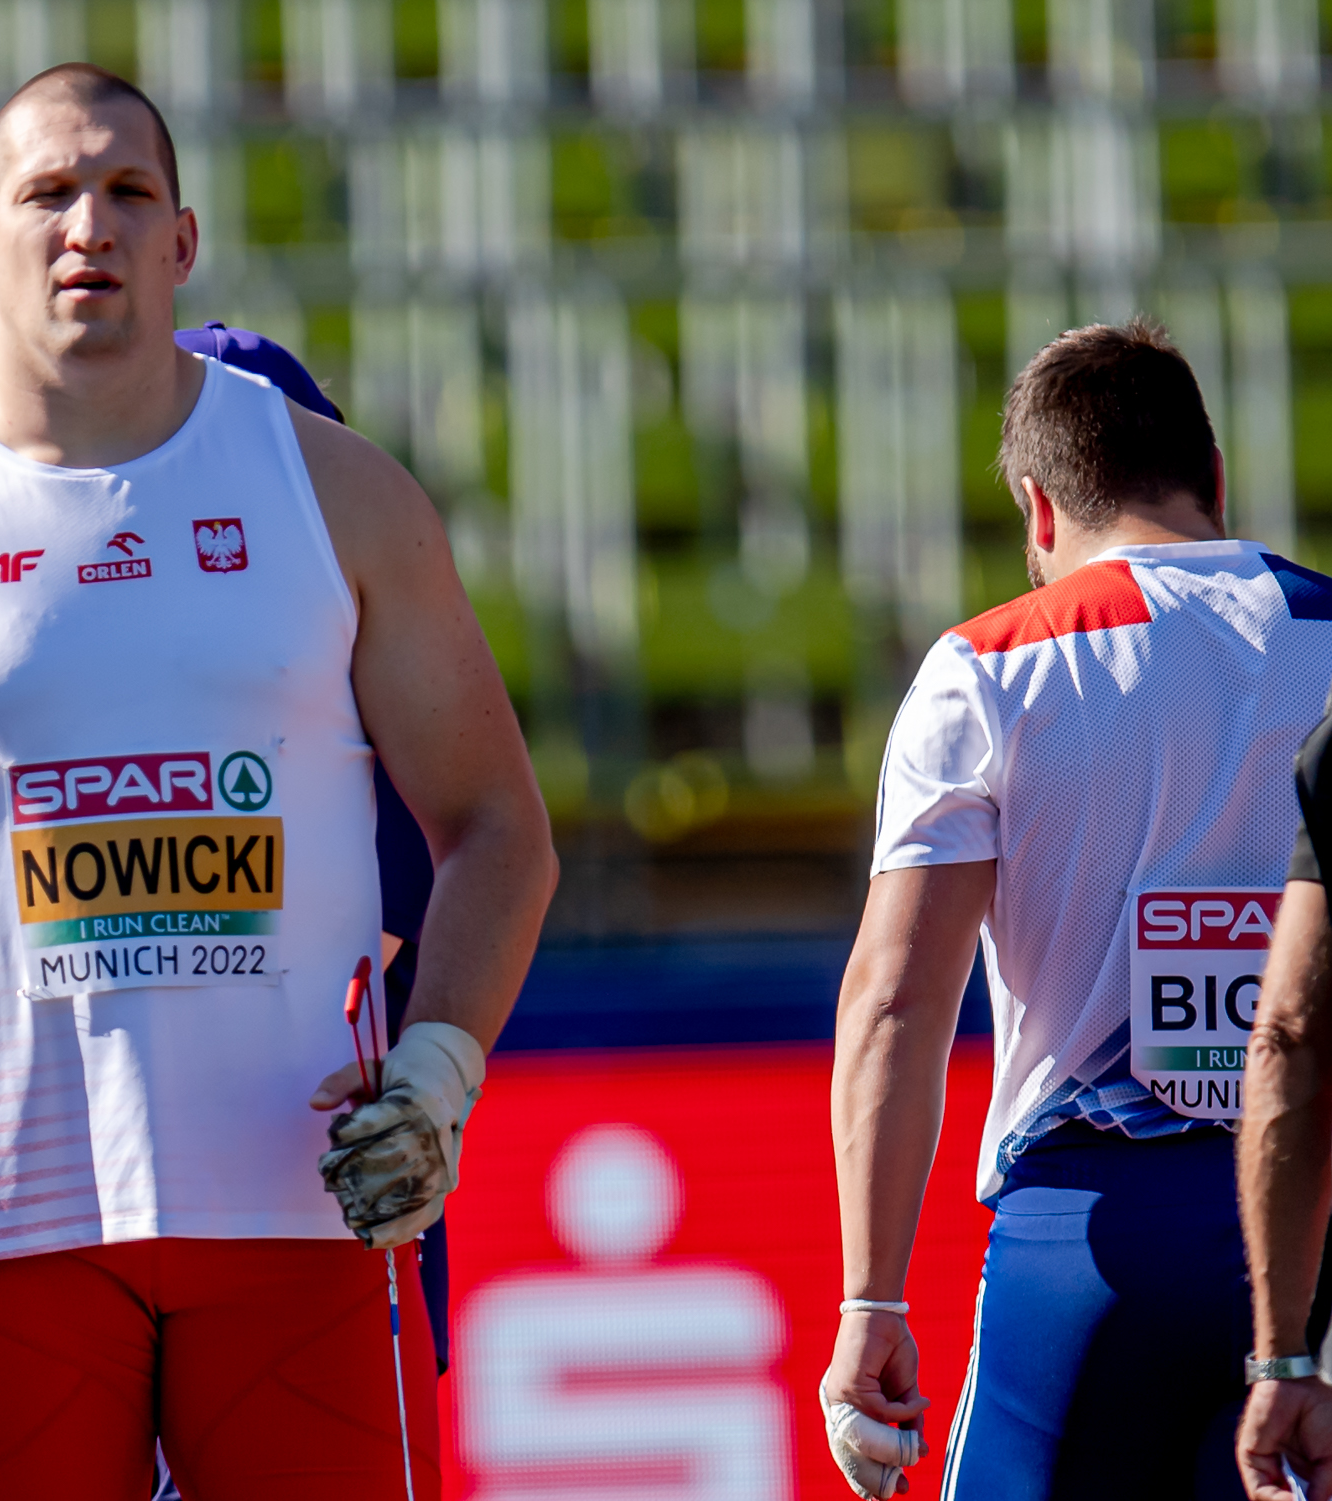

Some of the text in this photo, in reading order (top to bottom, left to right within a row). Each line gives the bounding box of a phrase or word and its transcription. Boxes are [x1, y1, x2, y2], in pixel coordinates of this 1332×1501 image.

[81, 561, 148, 581] ORLEN
[16, 759, 208, 815] SPAR
[21, 834, 274, 907] NOWICKI
[79, 920, 86, 939] I
[93, 915, 143, 937] RUN
[1143, 900, 1274, 941] SPA
[40, 944, 266, 986] MUNICH 2022
[1151, 974, 1263, 1031] BIG
[1196, 1049, 1201, 1068] I
[1150, 1079, 1241, 1109] MUNI
